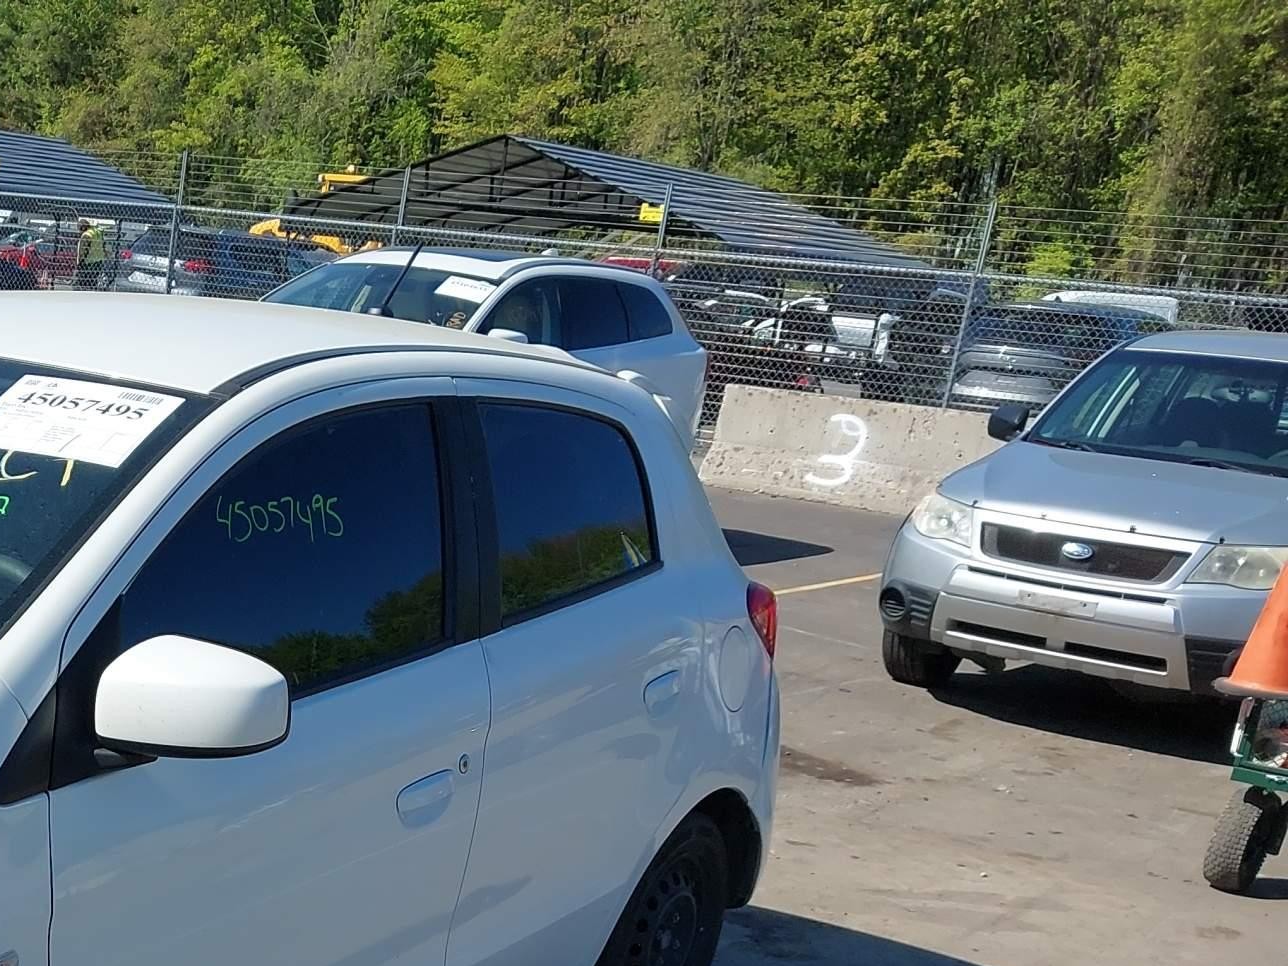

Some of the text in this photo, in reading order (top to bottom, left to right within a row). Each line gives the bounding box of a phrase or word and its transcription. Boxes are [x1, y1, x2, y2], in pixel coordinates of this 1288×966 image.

[17, 391, 150, 420] 45057495
[804, 413, 868, 486] 3
[216, 494, 344, 543] 45057495
